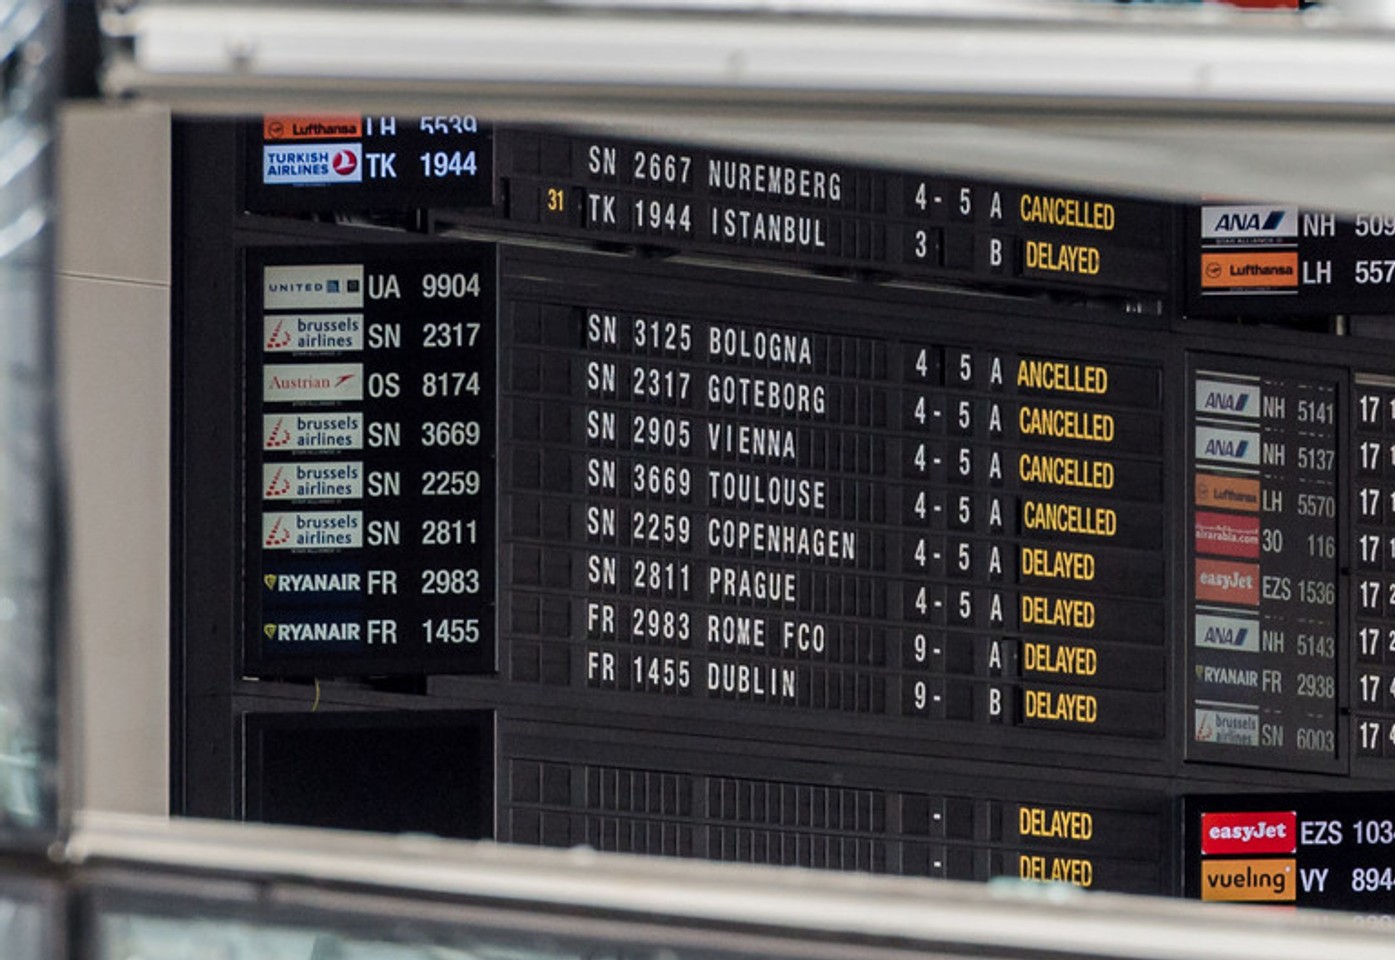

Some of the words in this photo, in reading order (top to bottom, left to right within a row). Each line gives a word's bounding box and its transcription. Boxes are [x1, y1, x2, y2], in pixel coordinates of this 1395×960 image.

[268, 152, 328, 163] TURKISH
[268, 164, 328, 175] AIRLINES
[366, 153, 396, 178] TK
[421, 151, 477, 176] 1944
[589, 146, 615, 175] SN
[635, 151, 690, 183] 2667
[709, 160, 840, 200] NUREMBERG
[1021, 195, 1114, 230] CANCELLED
[589, 194, 615, 223] TK
[636, 200, 690, 231] 1944
[713, 208, 824, 246] ISTANBUL
[1027, 241, 1099, 274] DELAYED
[1230, 264, 1293, 276] Lufthansa
[1303, 261, 1331, 284] LH
[269, 284, 322, 292] UNITED
[369, 275, 400, 299] UA
[423, 274, 480, 298] 9904
[298, 317, 358, 332] brussels
[369, 324, 400, 348] SN
[423, 323, 480, 347] 2317
[298, 333, 352, 347] airlines
[589, 314, 616, 343] SN
[635, 320, 690, 351] 3125
[710, 327, 811, 364] BOLOGNA
[269, 376, 330, 390] Austrian
[369, 373, 400, 397] OS
[423, 372, 480, 397] 8174
[588, 362, 614, 391] SN
[634, 368, 689, 398] 2317
[709, 375, 824, 413] GOTEBORG
[1020, 407, 1114, 441] CANCELLED
[589, 459, 614, 488] SN
[634, 464, 689, 495] 3669
[709, 471, 824, 508] TOULOUSE
[1025, 501, 1116, 535] CANCELLED
[588, 507, 614, 535] SN
[634, 512, 689, 543] 2259
[709, 519, 854, 559] COPENHAGEN
[1023, 548, 1094, 580] DELAYED
[278, 623, 360, 640] RYANAIR
[368, 620, 396, 643] FR
[423, 619, 479, 643] 1455
[589, 604, 613, 633] FR
[634, 609, 689, 640] 2983
[708, 615, 764, 646] ROME
[784, 622, 824, 652] FCO
[1025, 643, 1096, 675] DELAYED
[589, 652, 613, 680] FR
[634, 656, 689, 687] 1455
[708, 663, 794, 697] DUBLIN
[1026, 691, 1096, 722] DELAYED
[1205, 667, 1258, 686] RYANAIR
[1263, 670, 1281, 693] FR
[1297, 674, 1334, 698] 2938
[1020, 808, 1092, 839] DELAYED
[1209, 823, 1286, 841] easyJet
[1301, 821, 1342, 844] EZS
[1208, 866, 1285, 894] vueling
[1300, 869, 1328, 892] VY
